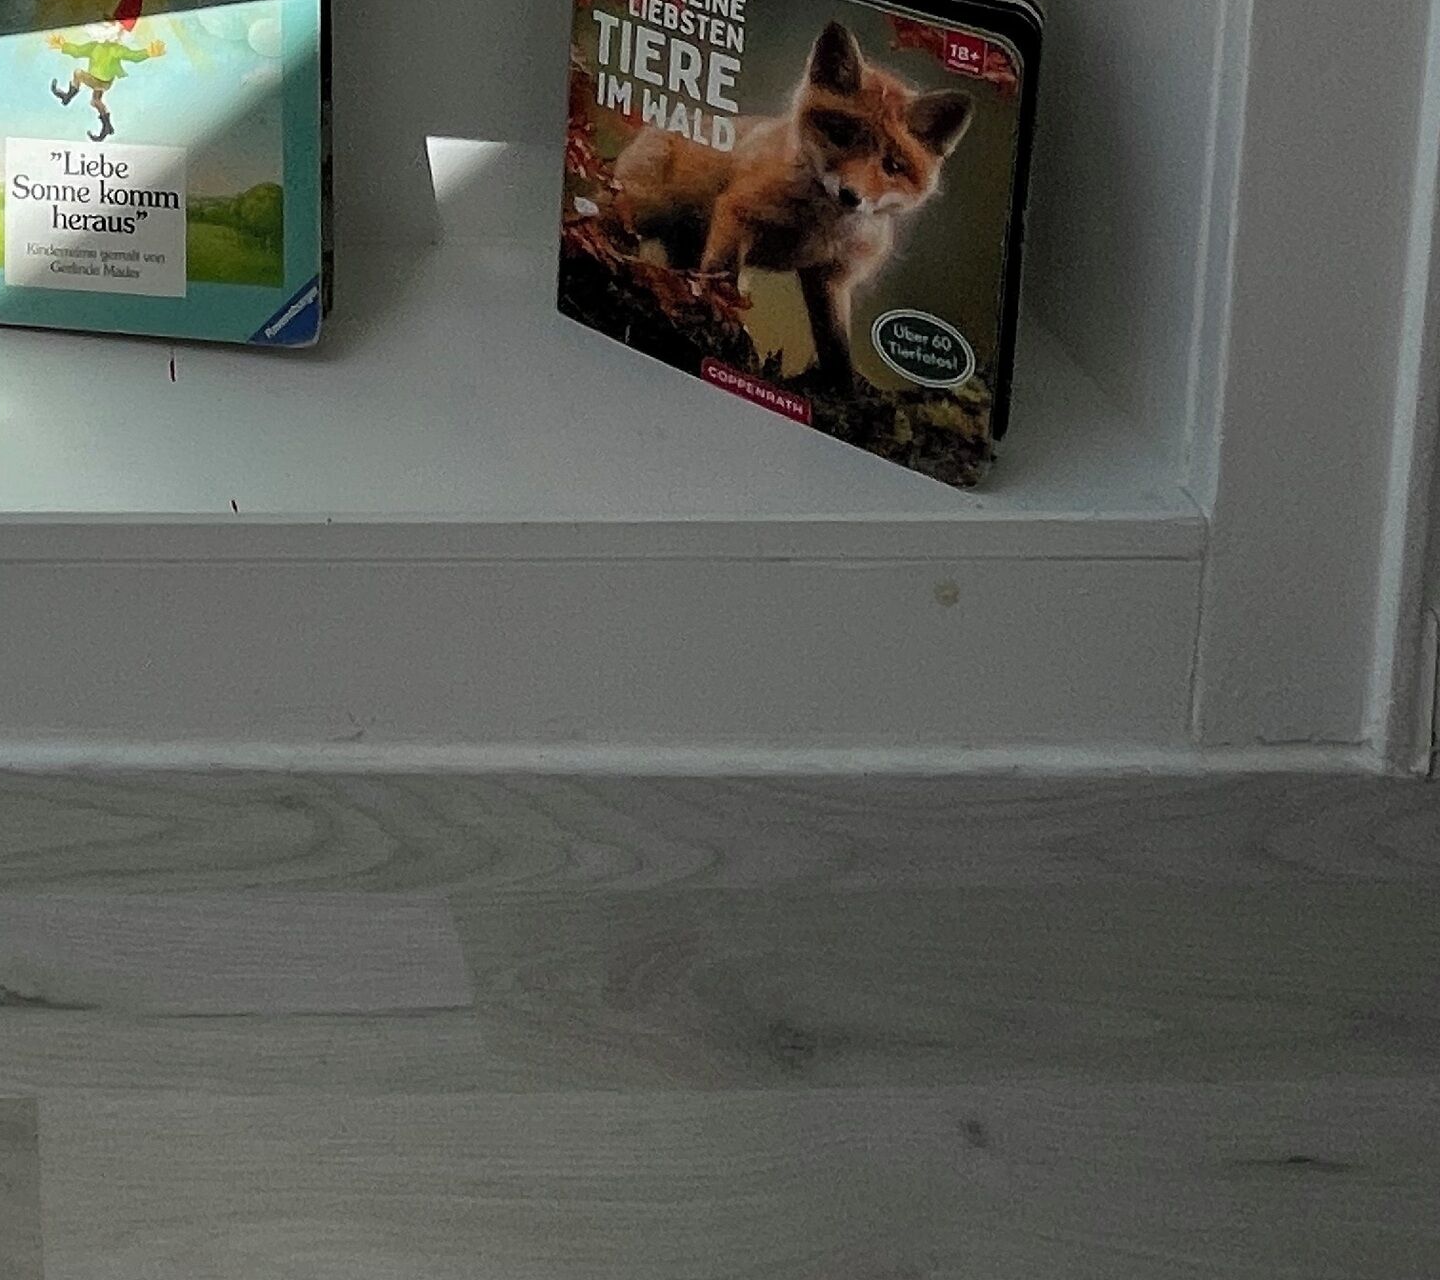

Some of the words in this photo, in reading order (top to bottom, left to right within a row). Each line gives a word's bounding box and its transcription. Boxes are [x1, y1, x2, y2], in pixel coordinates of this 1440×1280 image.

[592, 9, 741, 114] TIERE
[597, 71, 632, 116] IM
[642, 88, 736, 152] WALD
[11, 175, 91, 204] Sonne
[99, 179, 181, 210] komm
[707, 365, 804, 415] COPPENRATH
